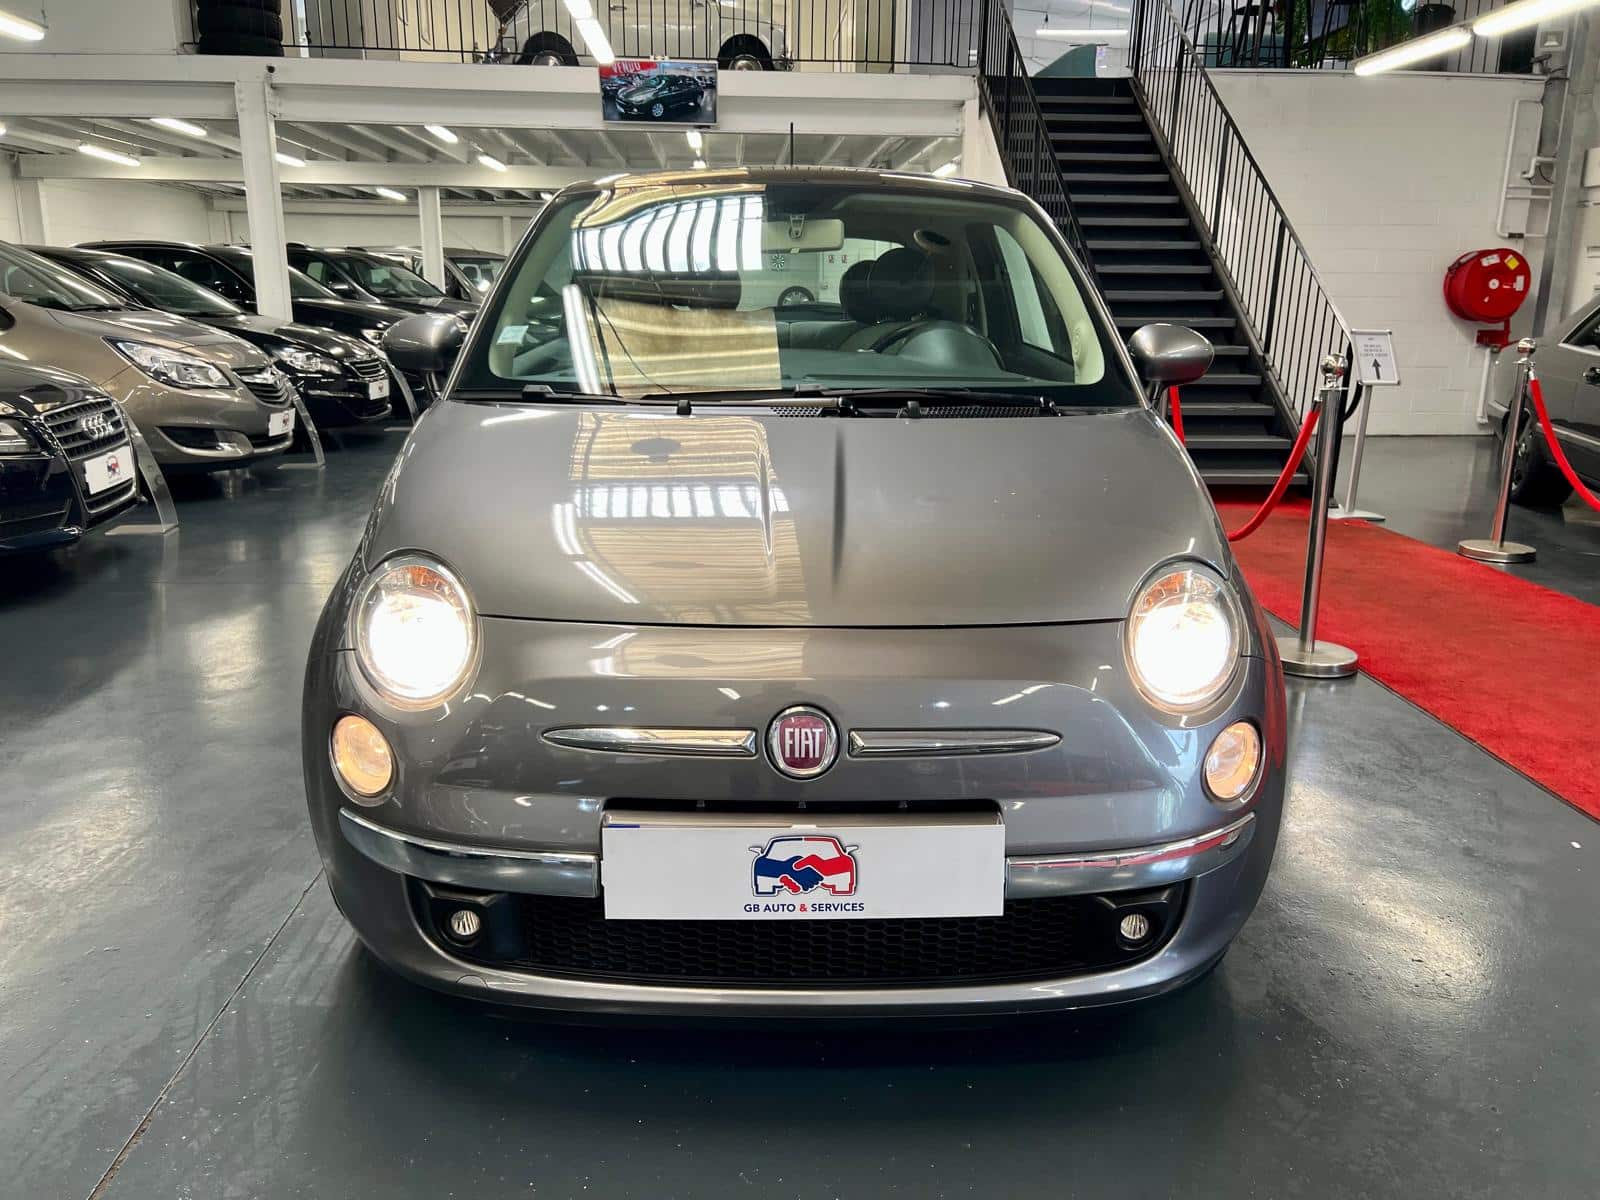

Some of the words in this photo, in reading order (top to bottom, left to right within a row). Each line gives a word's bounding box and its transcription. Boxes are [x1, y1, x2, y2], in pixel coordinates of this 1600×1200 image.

[784, 727, 823, 758] FIAT
[743, 903, 760, 912] GB
[763, 903, 796, 912] AUTO
[799, 903, 808, 912] &
[811, 902, 865, 912] SERVICES
